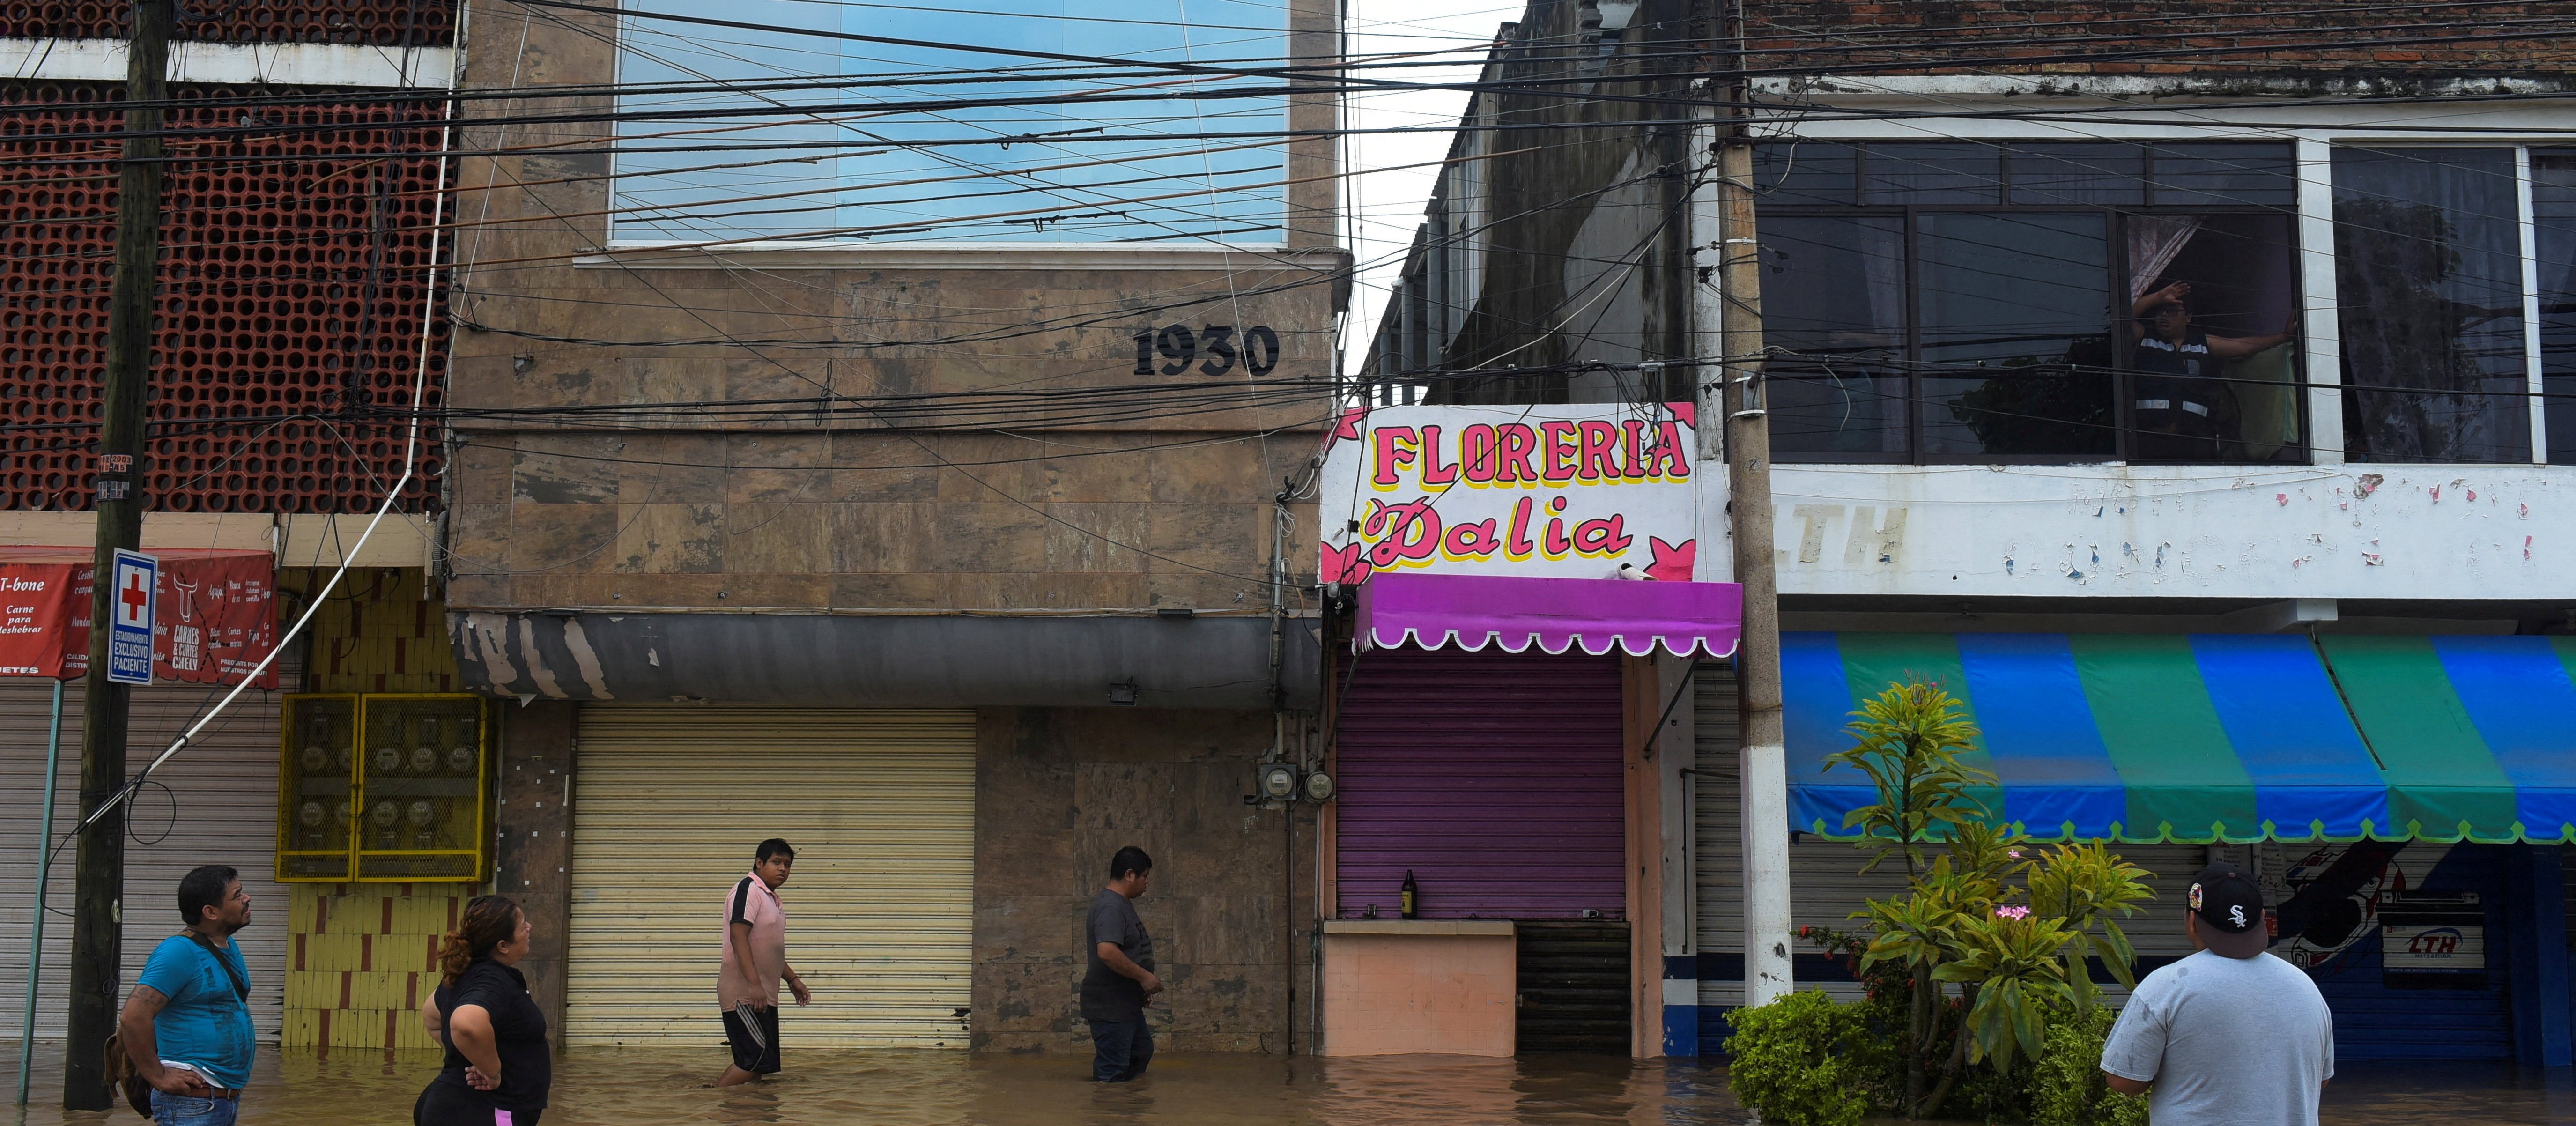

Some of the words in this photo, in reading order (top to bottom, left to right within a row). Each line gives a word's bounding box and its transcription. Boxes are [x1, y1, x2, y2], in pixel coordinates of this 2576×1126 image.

[1133, 323, 1280, 377] 1930
[1370, 420, 1690, 492] FLORERIA
[1361, 495, 1633, 571] Dalia
[1772, 504, 1908, 563] TH
[0, 577, 45, 592] T-bone
[207, 584, 223, 600] Aguja
[6, 605, 34, 614] Carne
[7, 616, 31, 626] para
[115, 630, 148, 645] ESTACIONAMIENTO
[173, 624, 199, 645] CARNES
[228, 627, 241, 636] Cortes
[114, 641, 148, 659] EXCLUSIVO
[173, 643, 178, 656] &
[179, 643, 198, 659] CORTES
[114, 656, 148, 673] PACIENTE
[172, 656, 198, 671] CHELY
[2409, 936, 2457, 953] LTH
